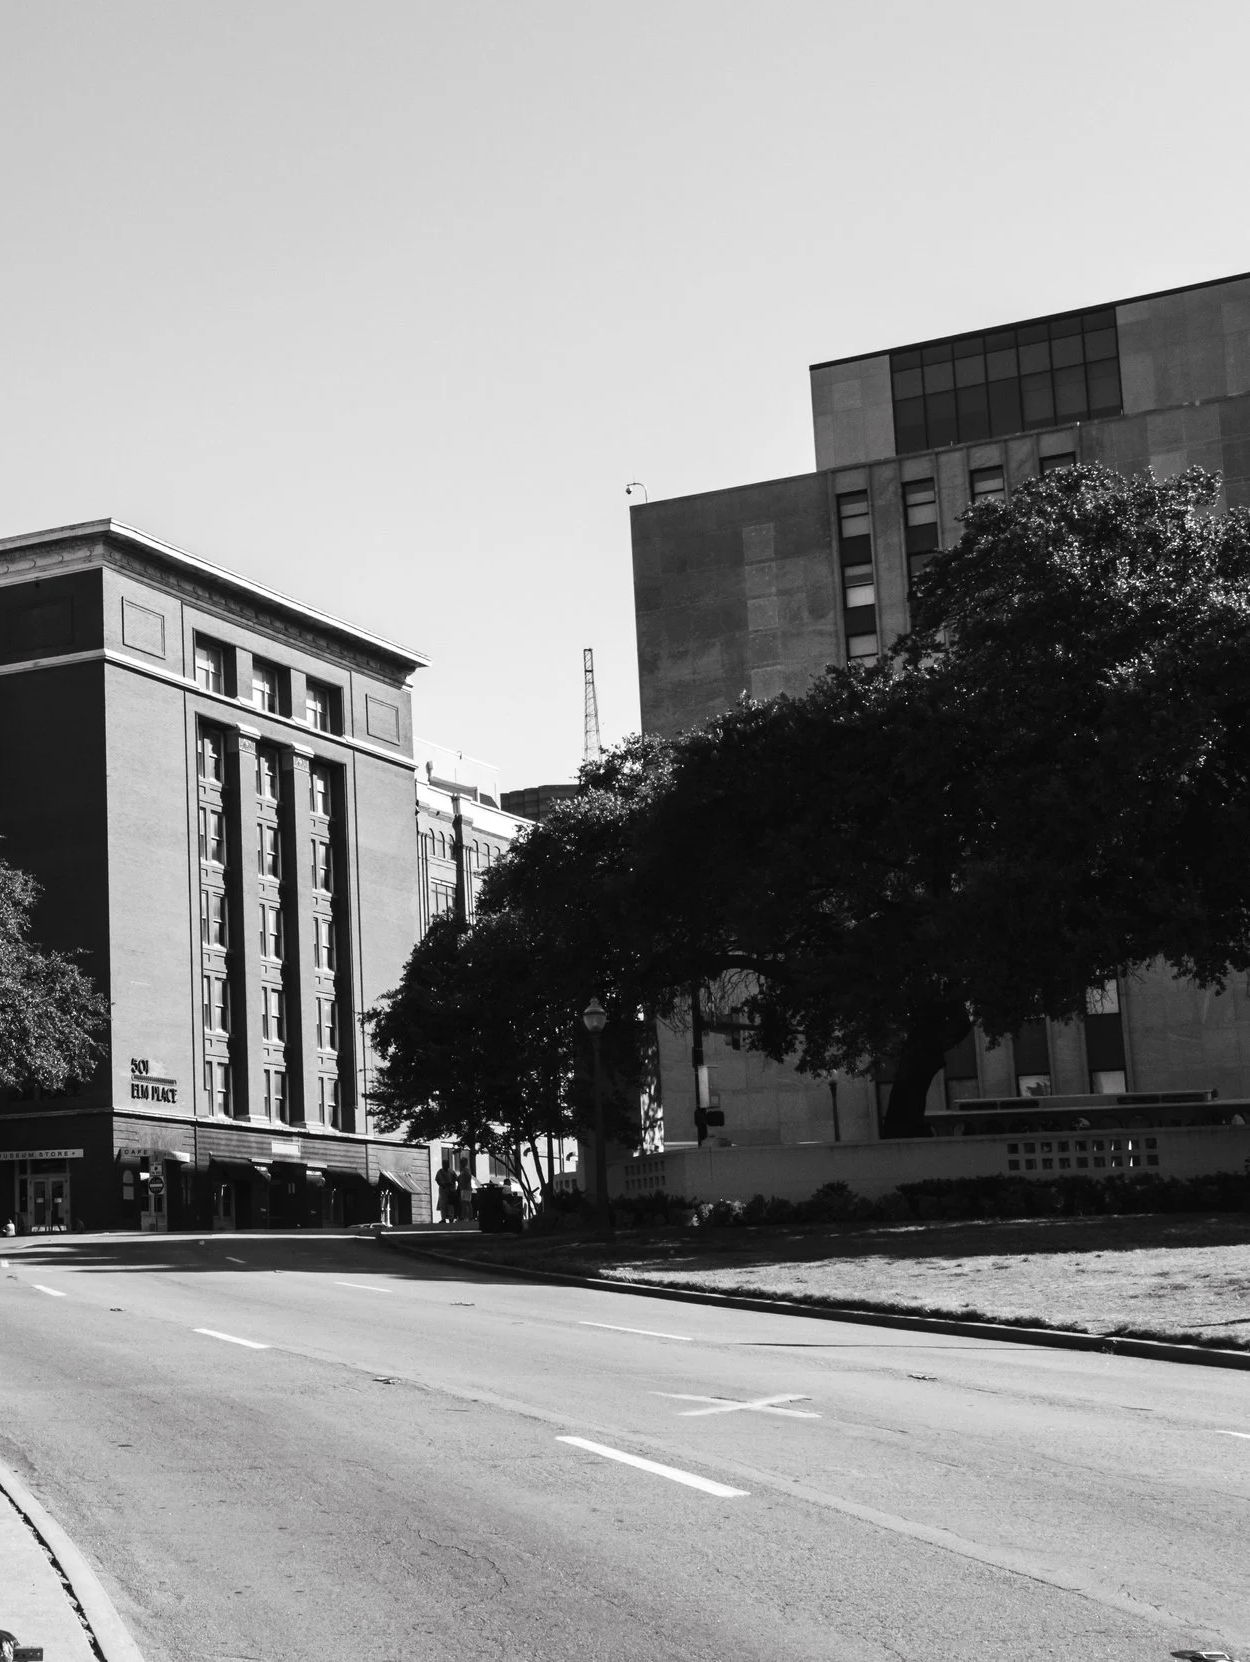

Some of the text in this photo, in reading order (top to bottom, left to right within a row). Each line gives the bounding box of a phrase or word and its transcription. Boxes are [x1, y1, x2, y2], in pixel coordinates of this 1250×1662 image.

[131, 1058, 148, 1074] 501
[132, 1083, 177, 1103] ELM PLACE
